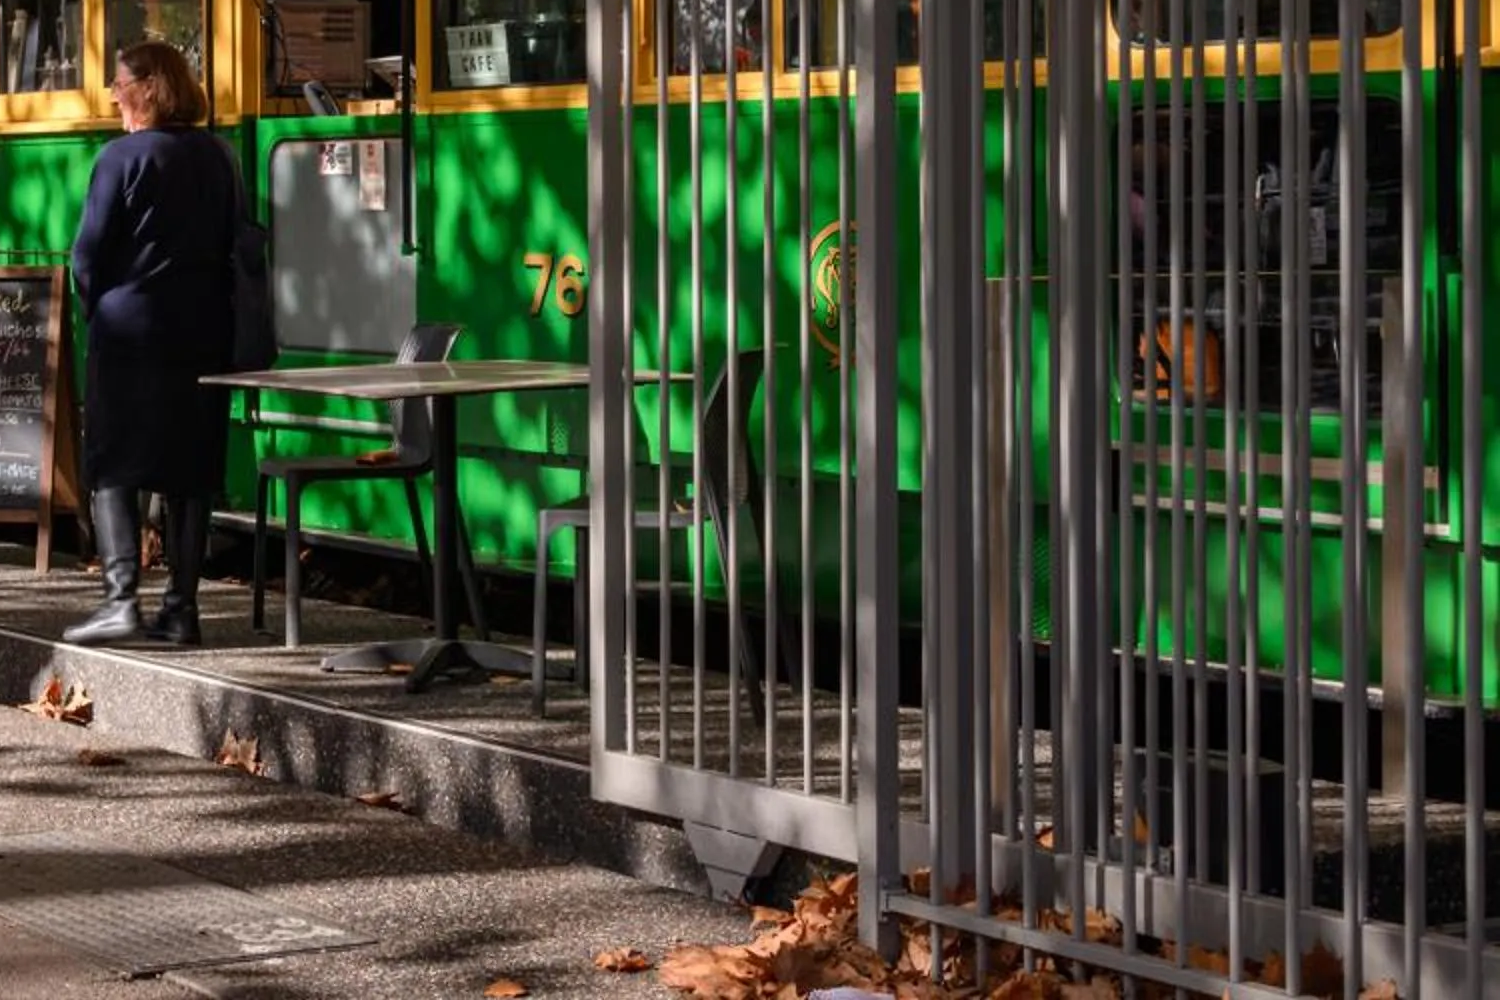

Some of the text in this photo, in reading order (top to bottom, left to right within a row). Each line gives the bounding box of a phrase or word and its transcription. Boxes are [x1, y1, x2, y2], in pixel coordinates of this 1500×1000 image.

[458, 29, 493, 49] TRAM
[461, 55, 494, 73] CAFE
[523, 251, 586, 316] 76
